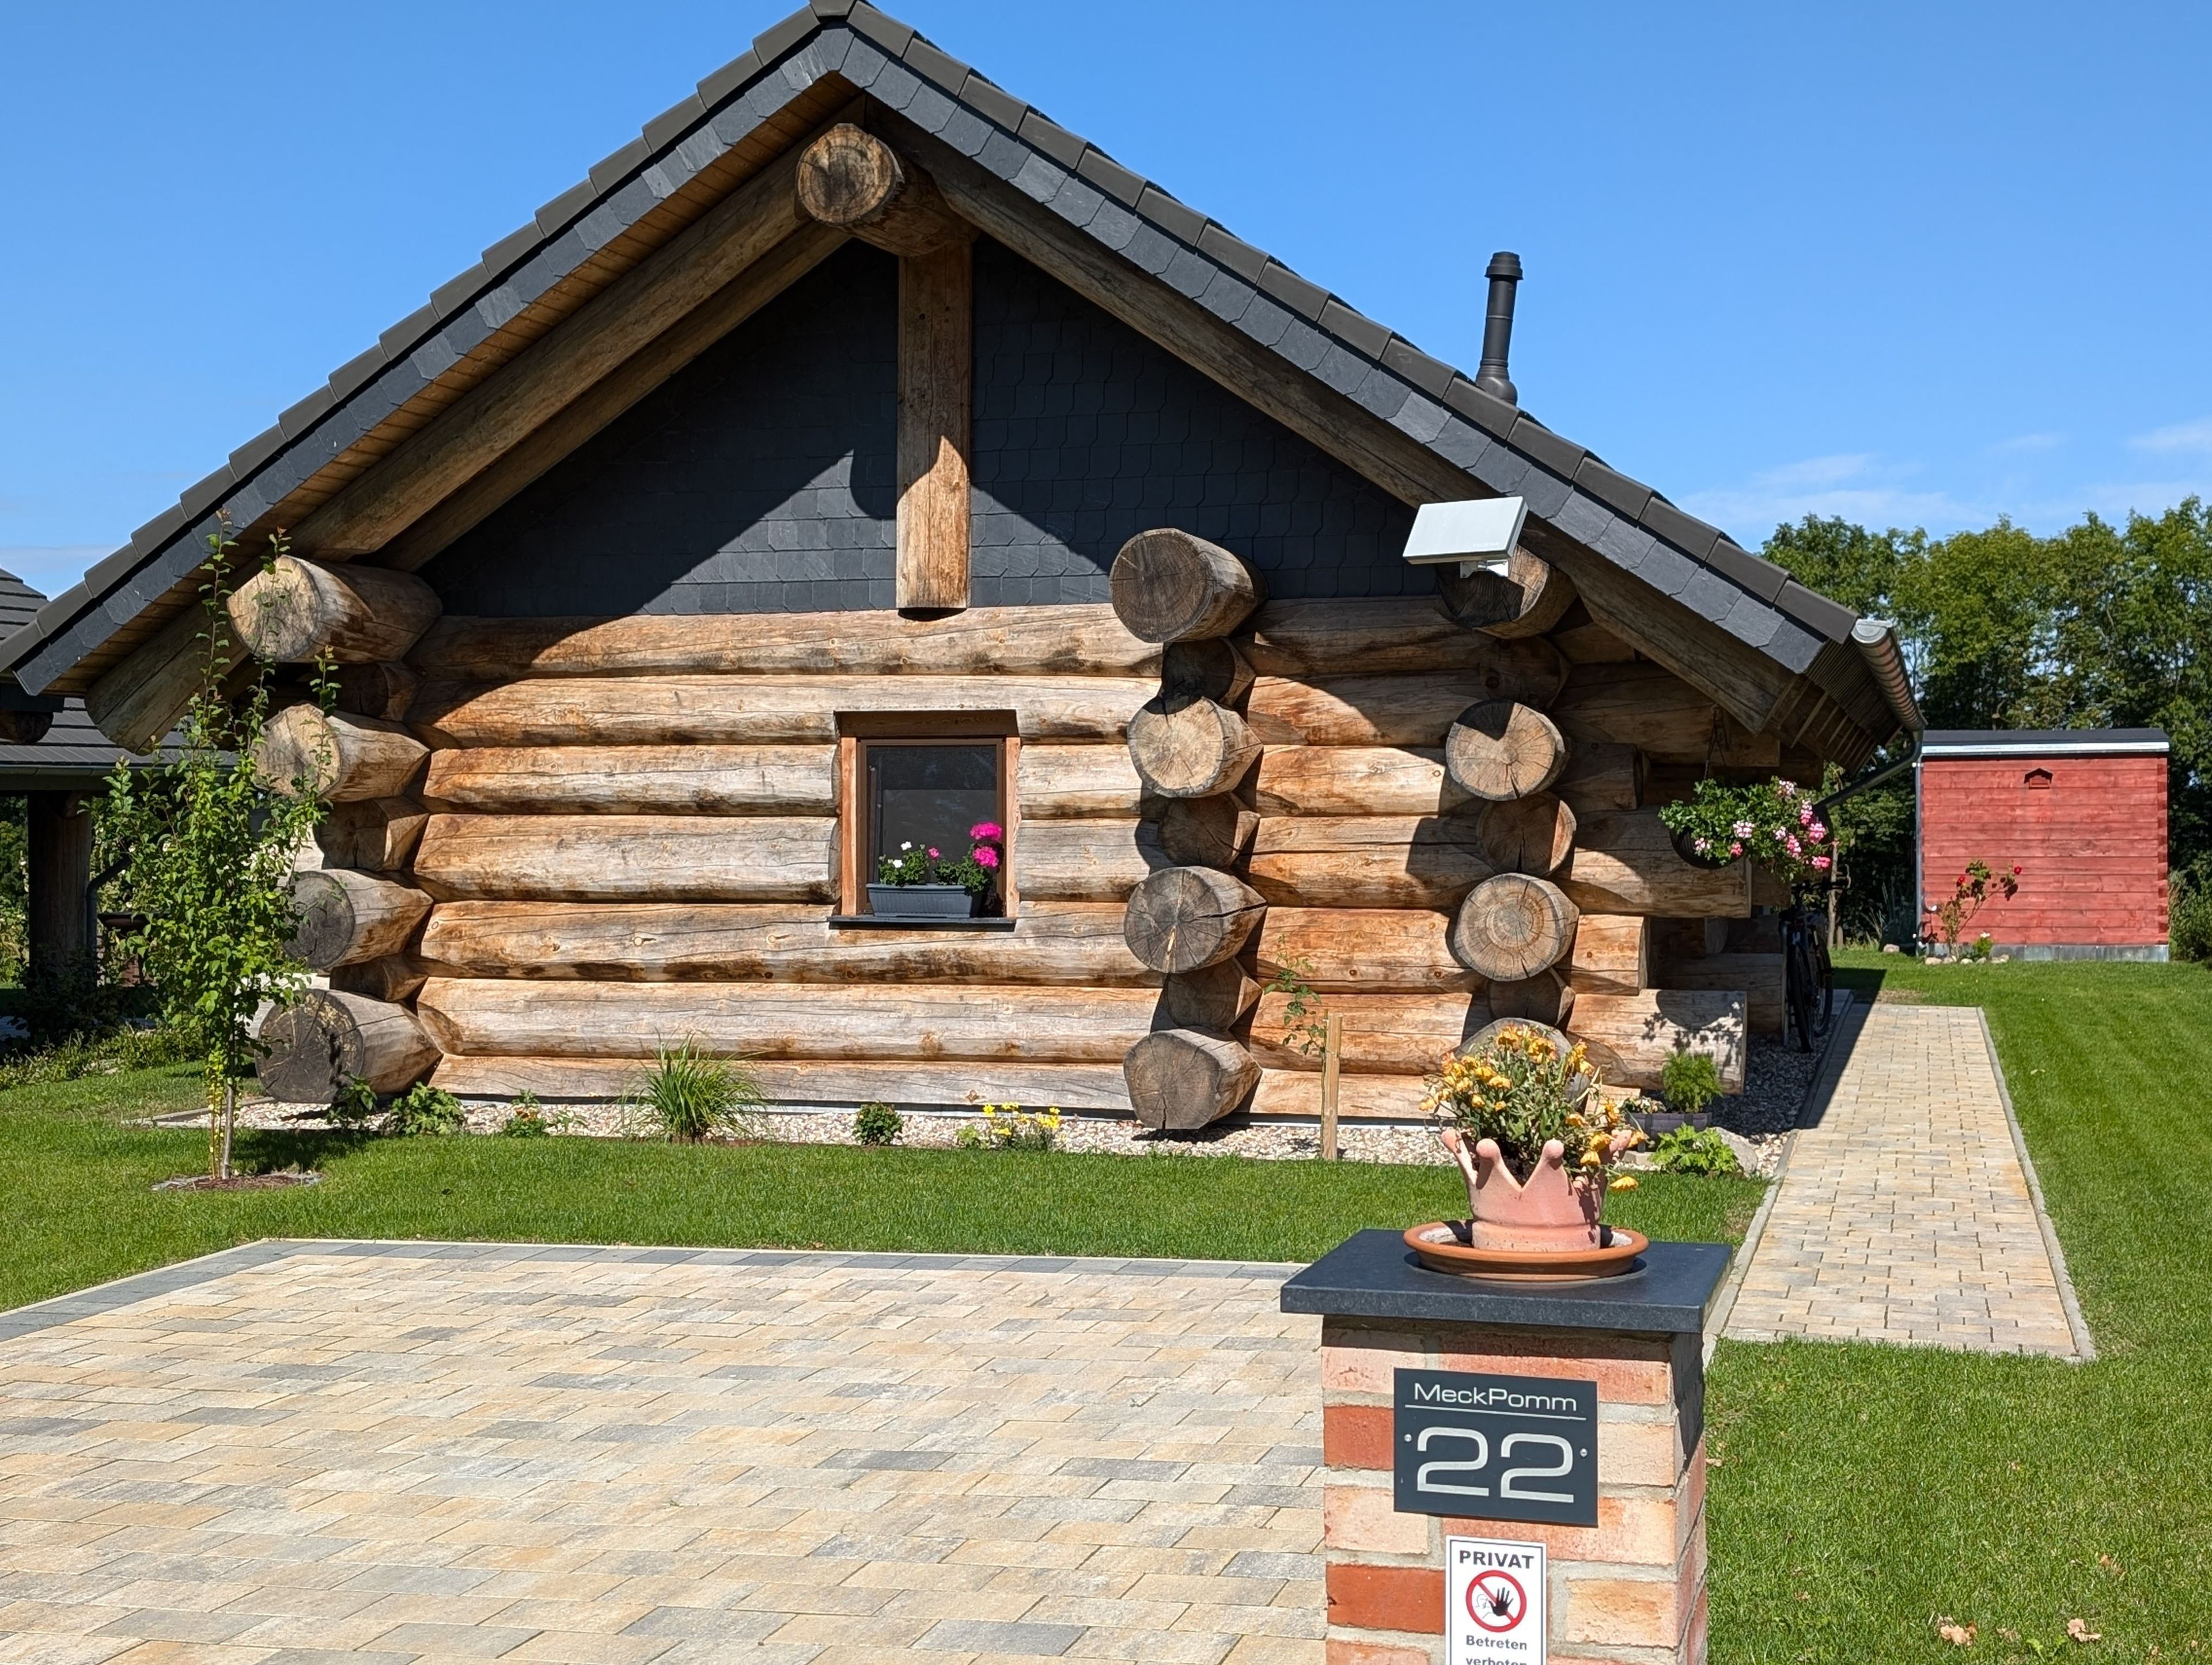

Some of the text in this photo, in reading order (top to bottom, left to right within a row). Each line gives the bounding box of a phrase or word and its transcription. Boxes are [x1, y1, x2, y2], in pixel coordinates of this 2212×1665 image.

[1414, 1383, 1577, 1411] MeckPomm
[1417, 1427, 1574, 1503] 22
[1459, 1550, 1534, 1569] PRIVAT
[1466, 1635, 1527, 1650] Betreten
